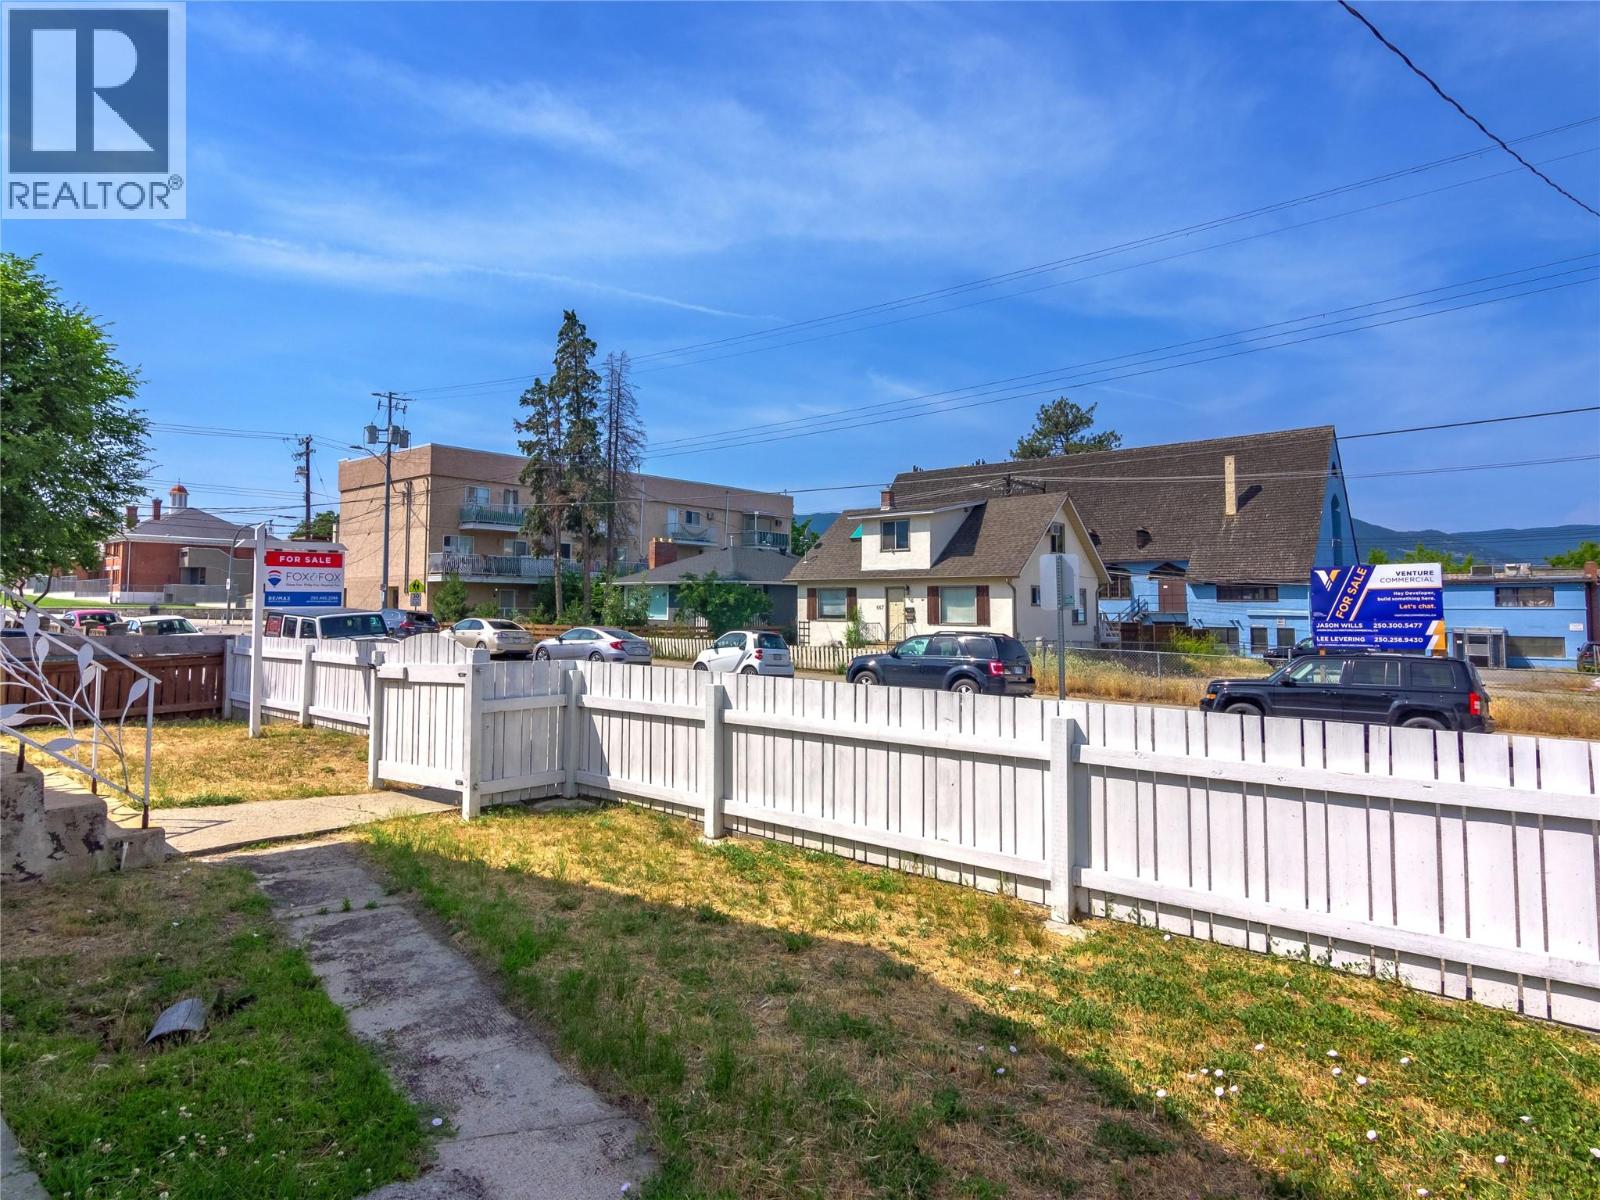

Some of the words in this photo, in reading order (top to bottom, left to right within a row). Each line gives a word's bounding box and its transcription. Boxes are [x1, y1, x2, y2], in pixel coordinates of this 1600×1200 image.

[279, 555, 301, 563] FOR
[304, 556, 332, 564] SALE
[1335, 596, 1354, 619] FOR
[1347, 566, 1368, 595] SALE
